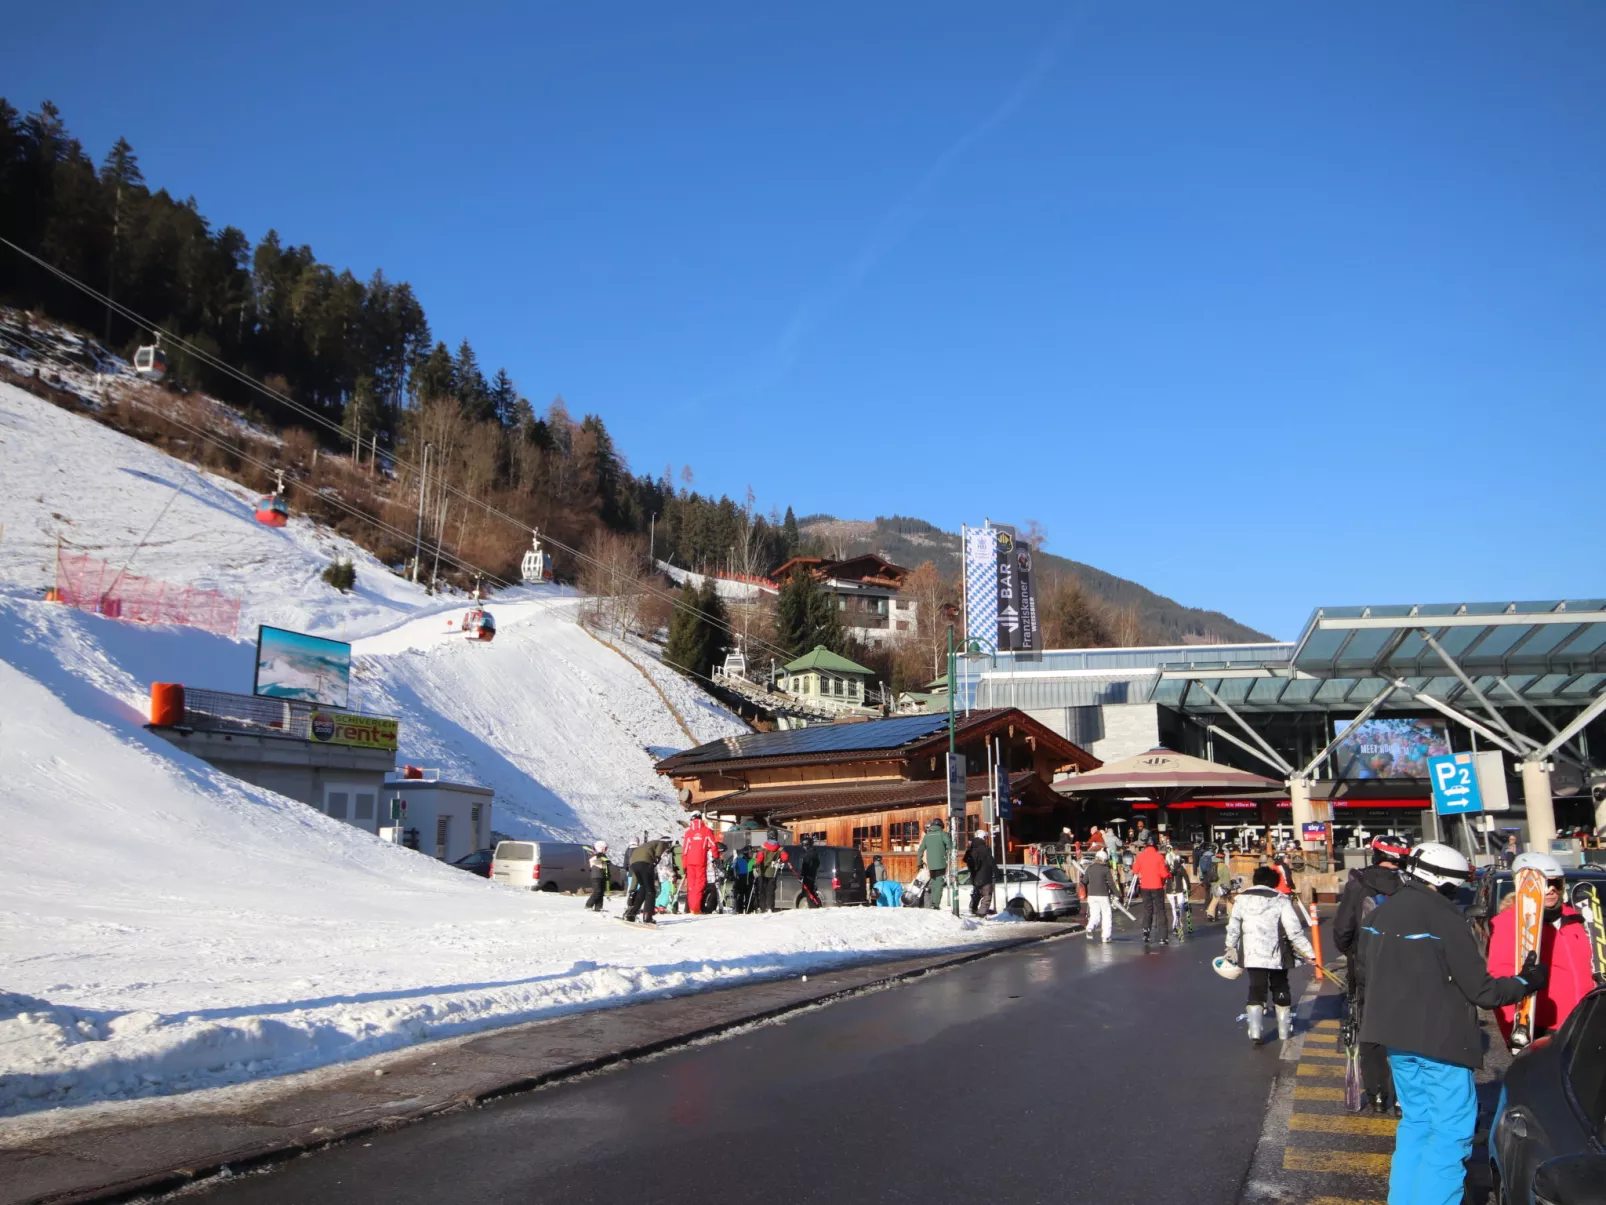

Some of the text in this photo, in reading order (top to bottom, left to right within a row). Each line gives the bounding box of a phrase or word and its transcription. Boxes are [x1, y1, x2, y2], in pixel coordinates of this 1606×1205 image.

[1000, 563, 1013, 599] BAR
[1020, 580, 1032, 648] Franziskaner
[1029, 596, 1037, 632] WEISSBIER
[335, 725, 380, 743] rent
[1360, 744, 1378, 754] MEET
[1435, 762, 1471, 791] P 2
[1307, 824, 1320, 832] sky
